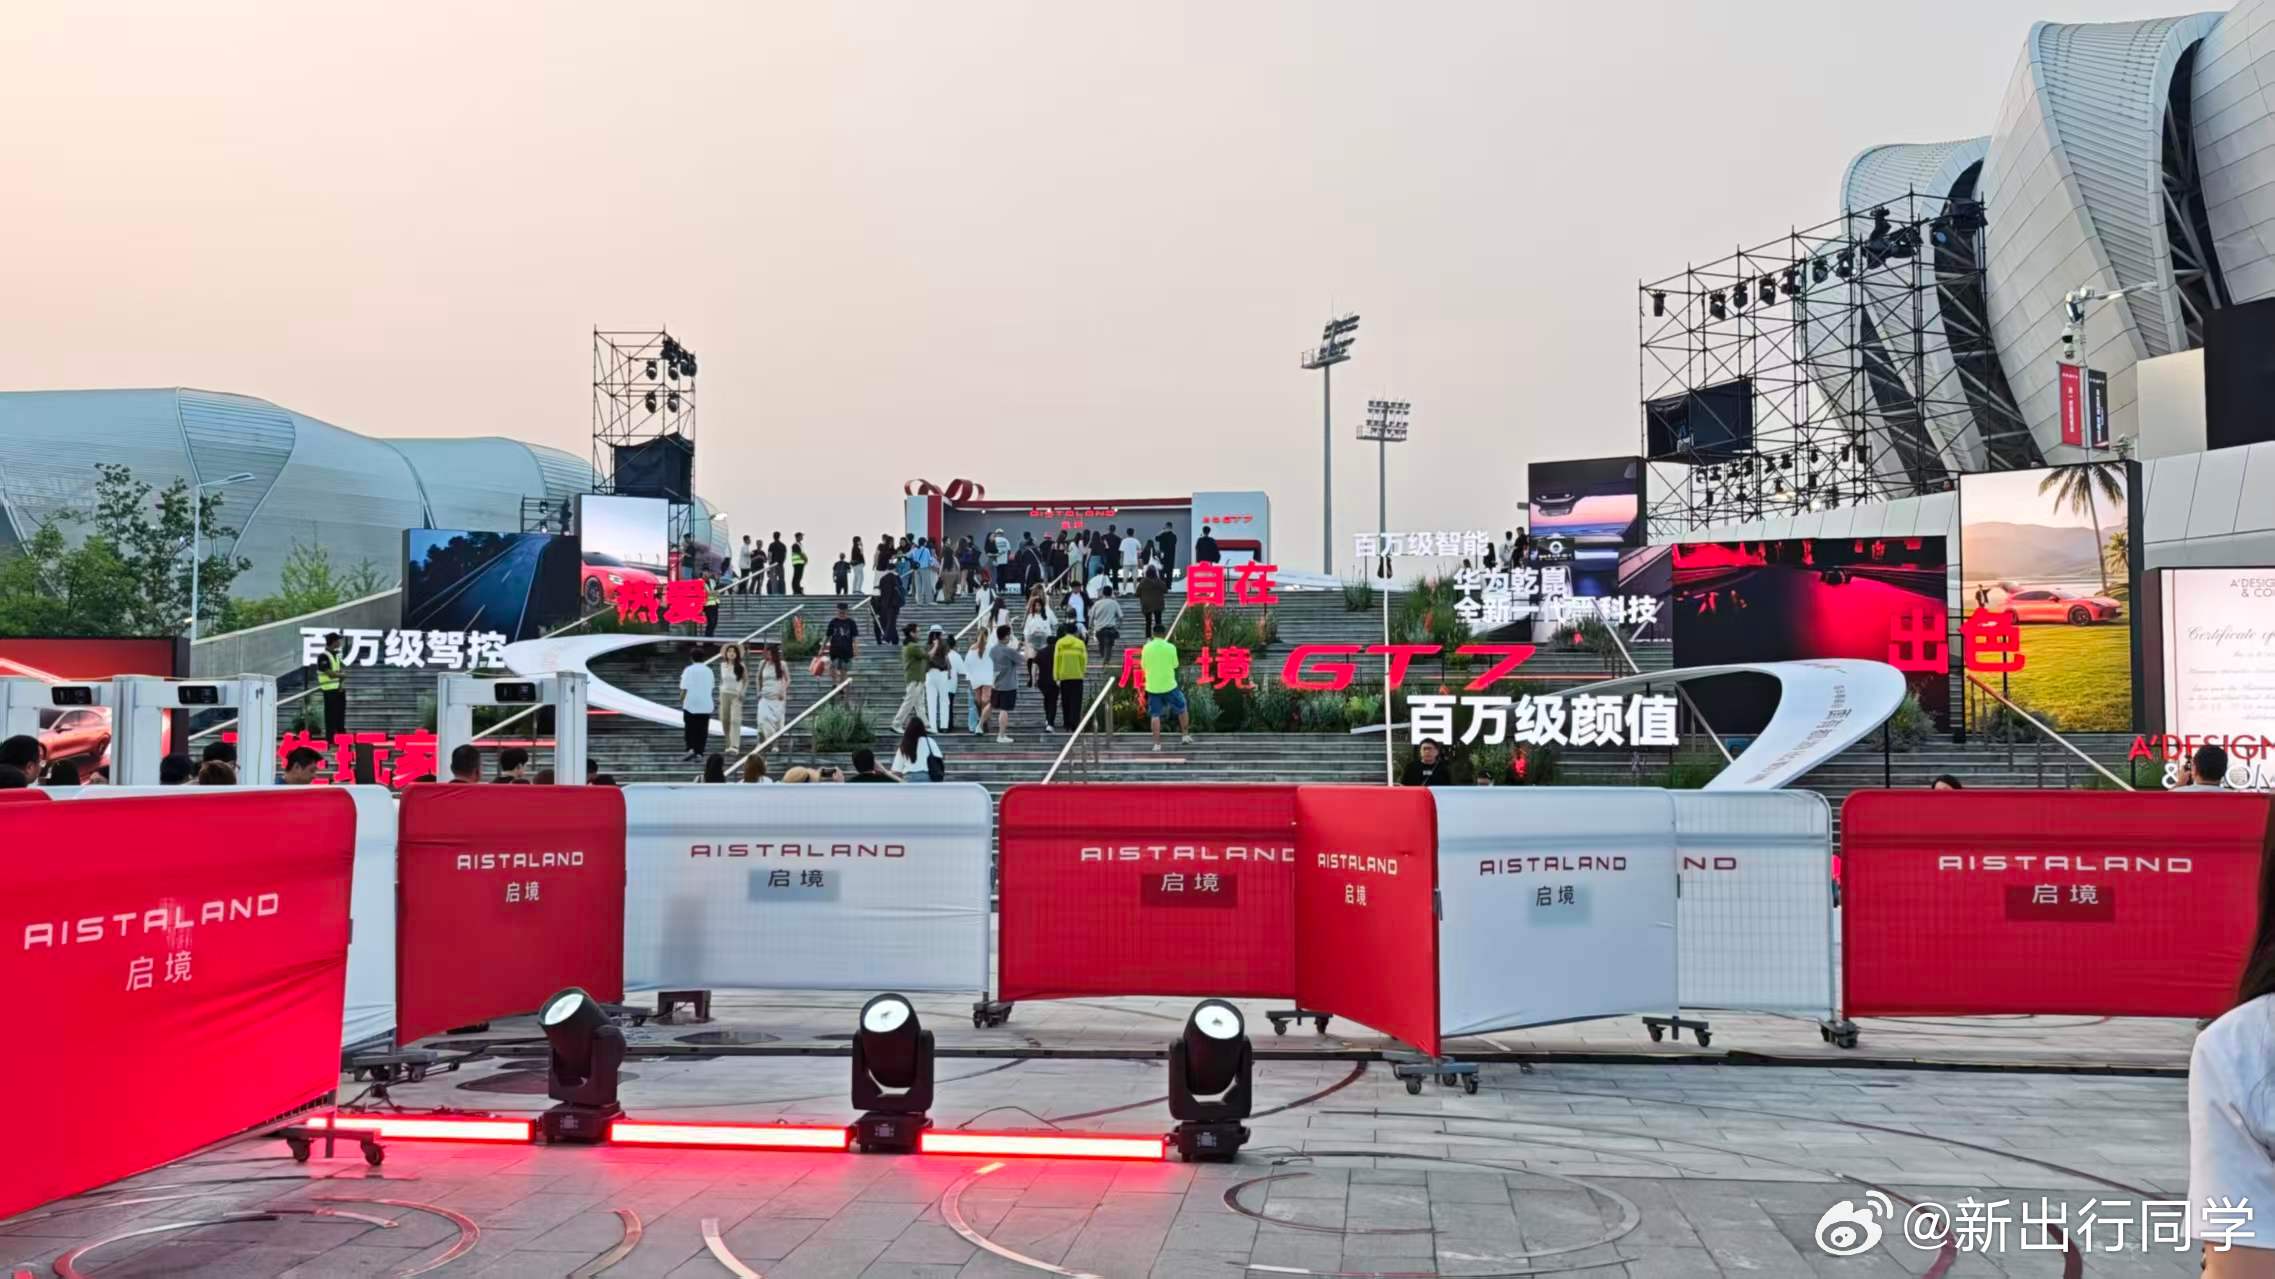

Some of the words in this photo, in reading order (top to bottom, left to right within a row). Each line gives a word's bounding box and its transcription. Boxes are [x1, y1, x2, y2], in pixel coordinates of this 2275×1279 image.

[1352, 530, 1490, 557] 百万级智能
[1186, 560, 1279, 607] 自在
[616, 578, 707, 625] 热爱
[1887, 607, 2026, 674] 出色
[1281, 644, 1537, 691] GT7
[1406, 693, 1680, 747] 百万级颜值
[457, 851, 584, 871] AISTALAND
[690, 844, 906, 858] AISTALAND
[1317, 853, 1398, 875] AISTALAND
[1479, 856, 1627, 876] AISTALAND
[1938, 855, 2193, 873] AISTALAND
[767, 868, 824, 888] 启境
[1160, 872, 1220, 892] 启境
[505, 881, 540, 903] 启境
[1344, 884, 1368, 907] 启境
[1536, 884, 1575, 906] 启境
[2031, 883, 2099, 905] 启境
[24, 893, 279, 950] AISTALAND
[126, 950, 193, 992] 启境
